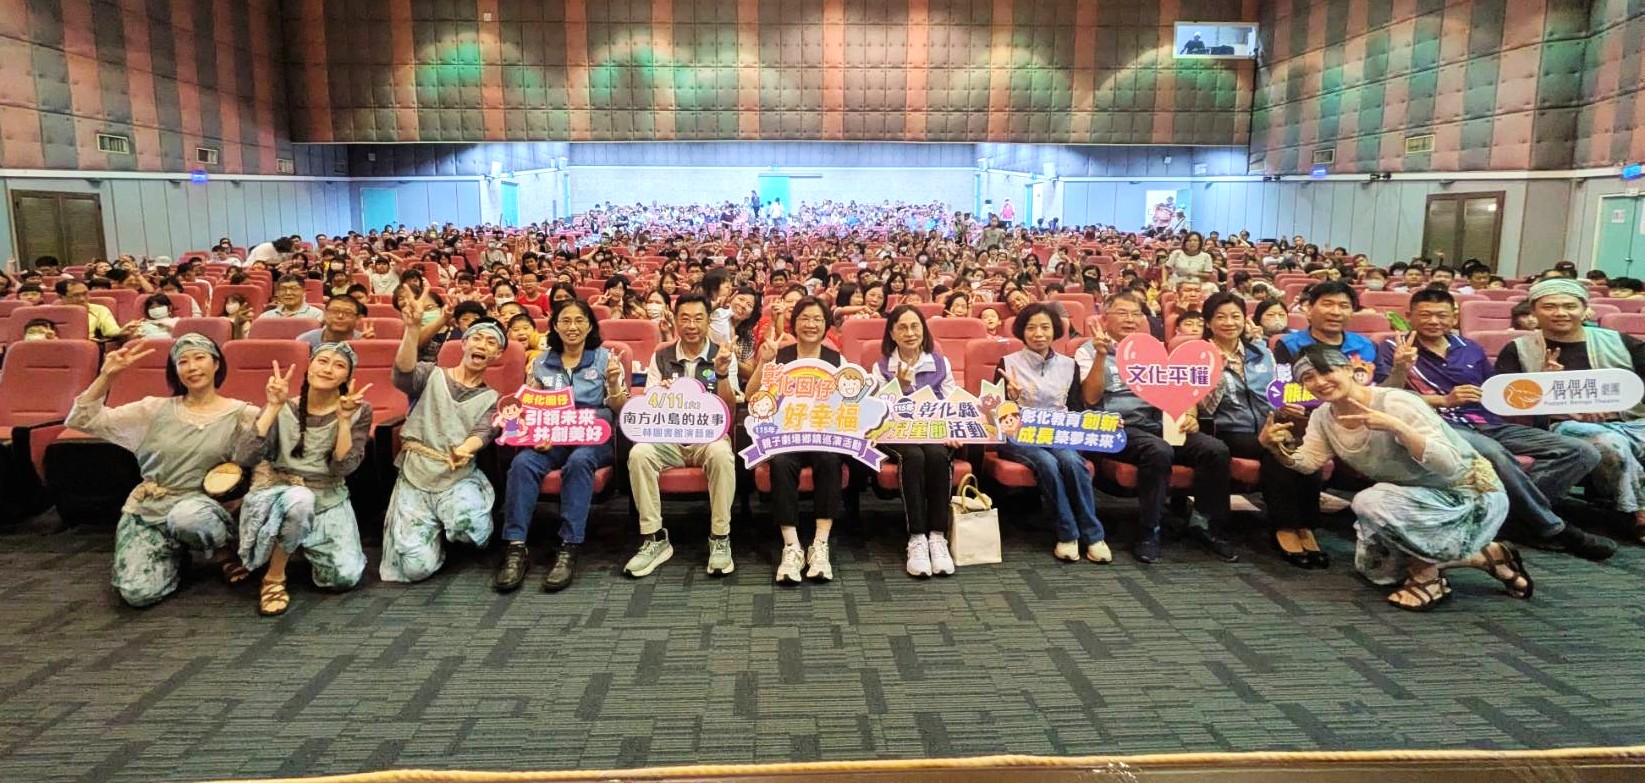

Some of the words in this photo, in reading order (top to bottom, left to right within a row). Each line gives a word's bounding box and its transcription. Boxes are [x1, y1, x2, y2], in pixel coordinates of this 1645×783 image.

[1127, 365, 1209, 386] 文化平權
[1552, 378, 1598, 399] 偶偶偶
[525, 408, 596, 426] 引領未來
[623, 411, 724, 426] 南方小島的故事
[783, 402, 859, 432] 好幸福
[893, 402, 915, 413] 115年
[917, 401, 979, 418] 彰化縣
[1022, 408, 1120, 432] 彰化教育創新
[533, 426, 603, 442] 共創美好
[631, 427, 715, 439] 二林圖書館演藝廳
[889, 420, 988, 439] 兒童節活動
[1018, 426, 1115, 448] 成長築夢未來
[762, 432, 861, 450] 親子劇場鄉鎮巡演活動
